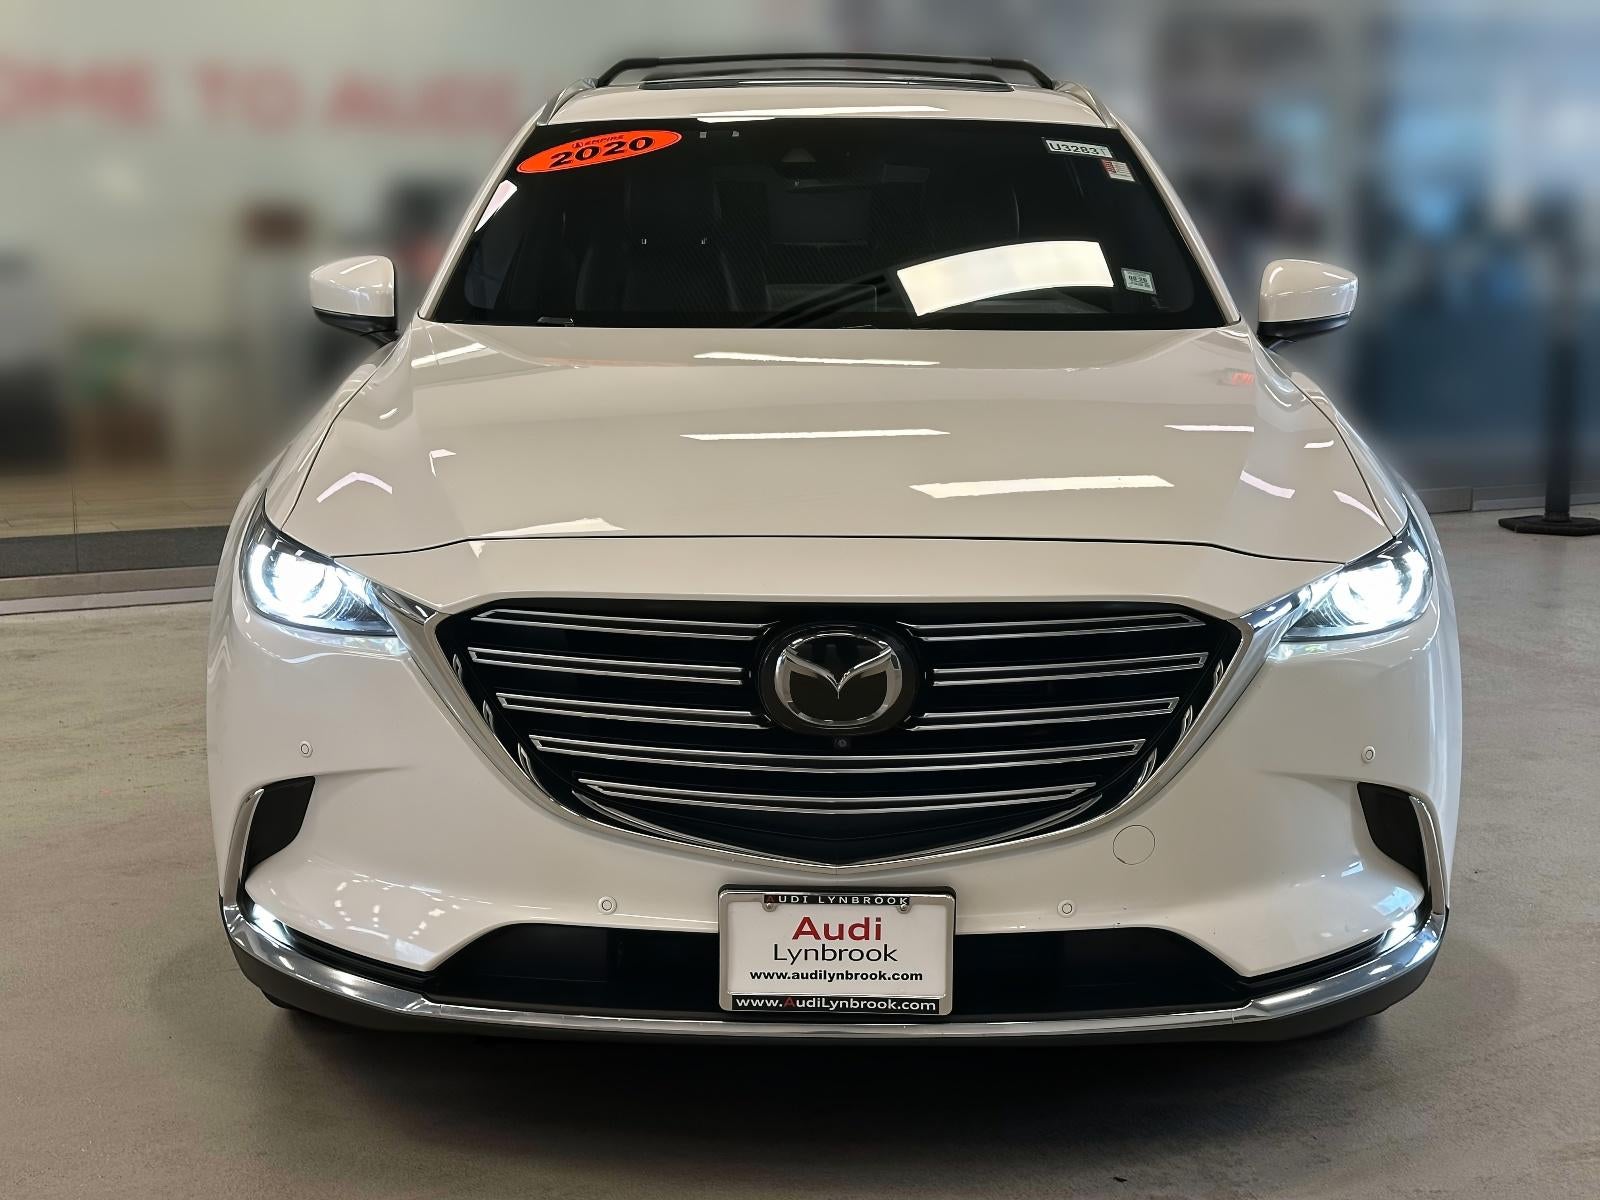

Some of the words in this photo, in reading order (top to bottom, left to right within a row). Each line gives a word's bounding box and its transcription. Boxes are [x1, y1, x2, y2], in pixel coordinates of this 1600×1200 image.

[548, 136, 655, 169] 2020
[818, 895, 909, 905] LYNBROOK
[791, 916, 883, 941] Audi
[772, 943, 899, 966] Lynbrook
[749, 970, 924, 983] www.audilynbrook.com
[735, 996, 937, 1012] www.AudiLynbrook.com
